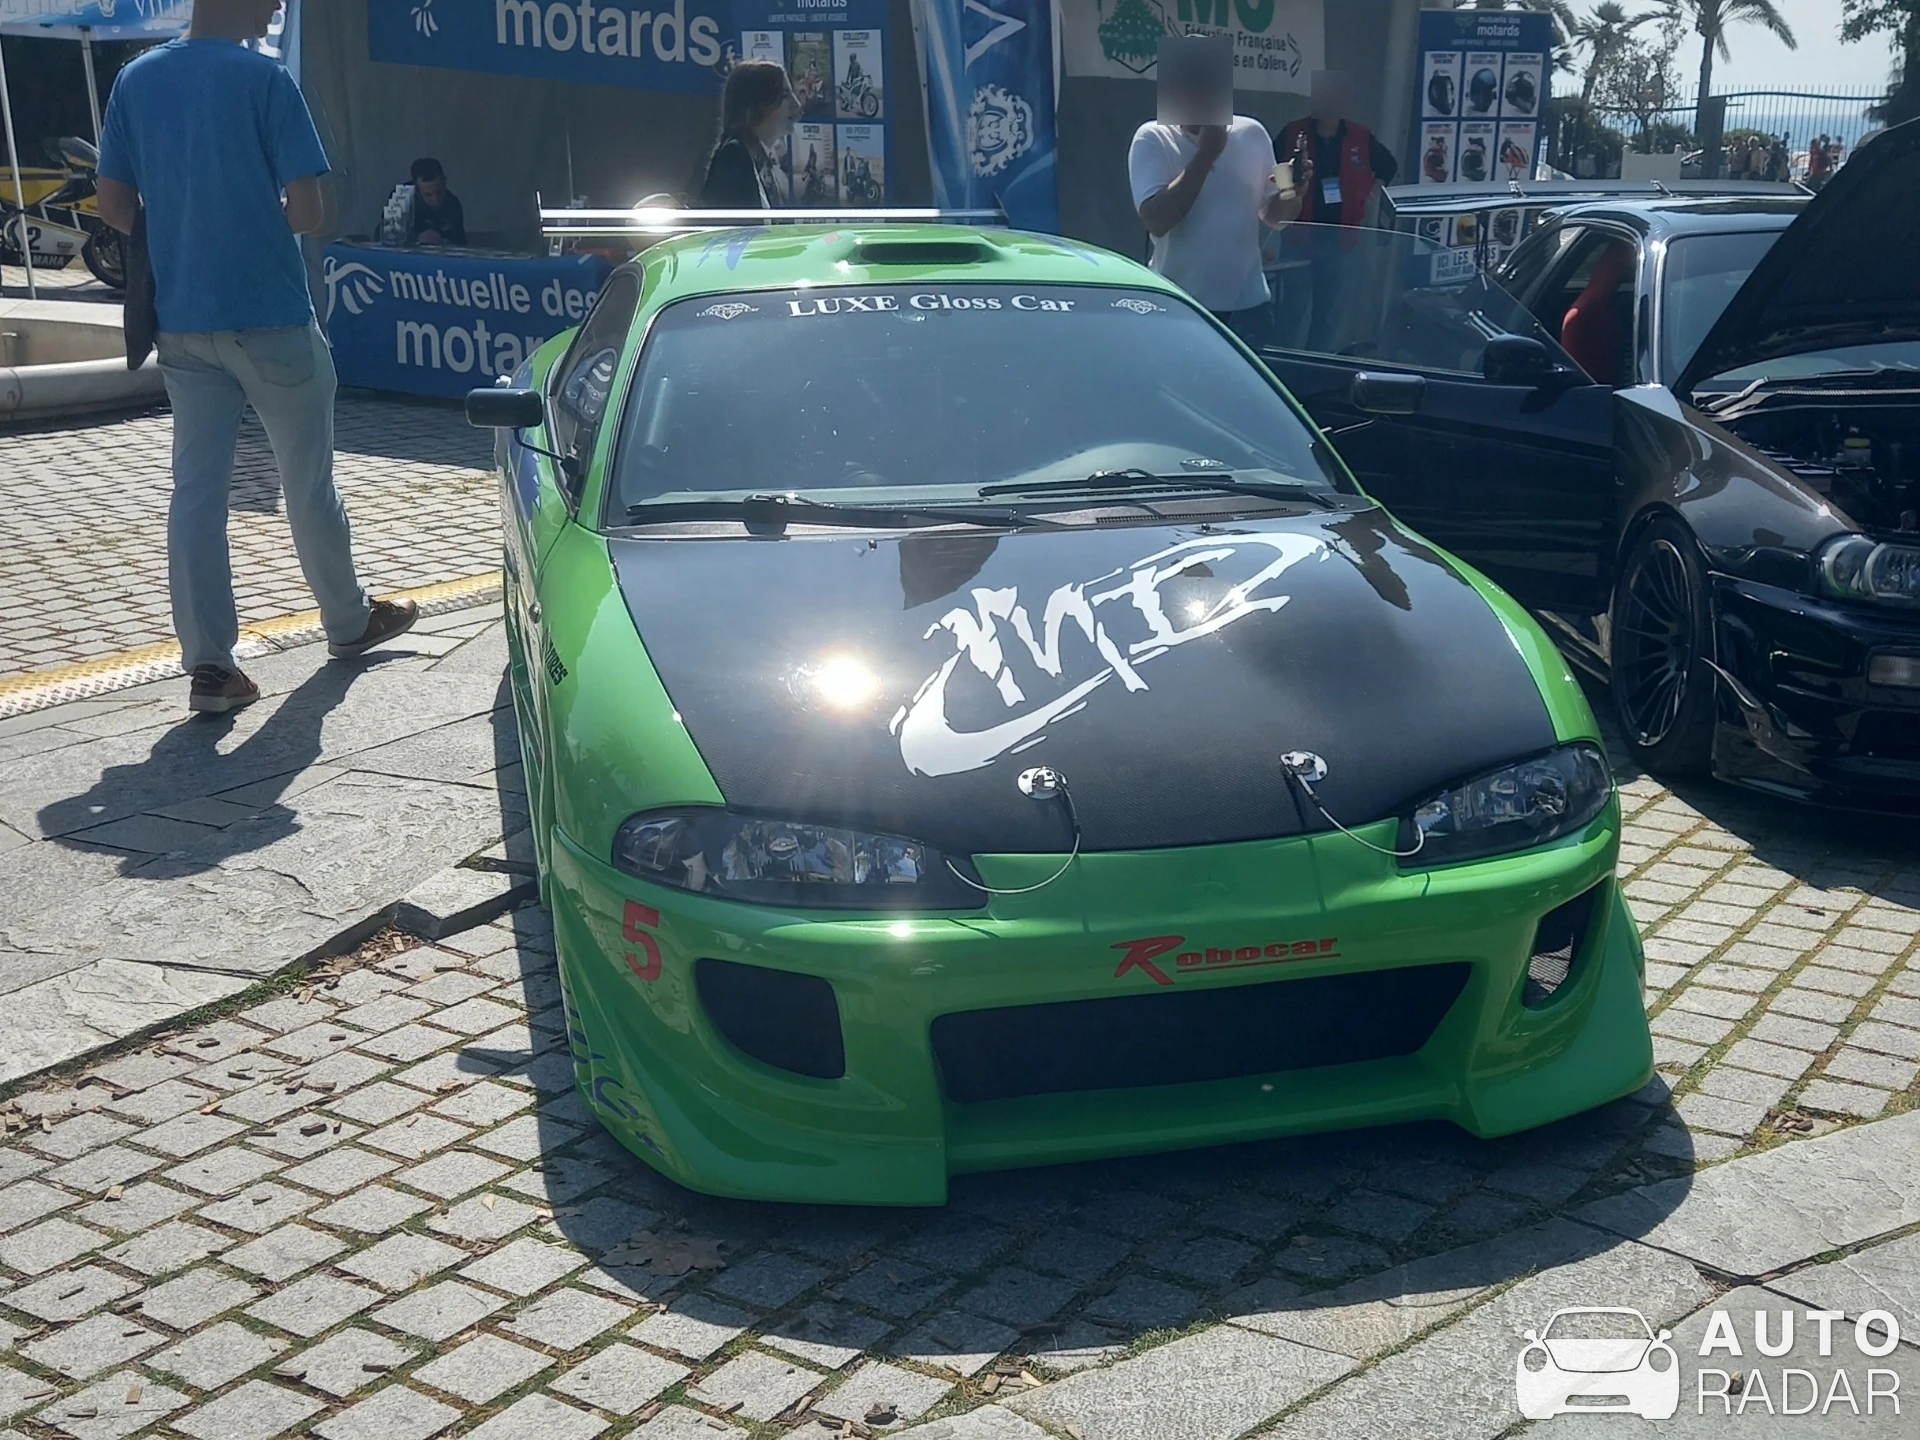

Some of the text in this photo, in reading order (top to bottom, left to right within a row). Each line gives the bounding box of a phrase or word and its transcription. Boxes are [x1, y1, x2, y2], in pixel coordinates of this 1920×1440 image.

[496, 0, 721, 66] motards
[1238, 31, 1286, 52] Française
[1477, 25, 1520, 36] motards
[1257, 54, 1287, 71] Colère
[20, 254, 64, 266] YMAHA
[389, 269, 601, 319] mutuelle des
[786, 294, 1075, 317] LUXE Gloss Car
[622, 899, 662, 982] 5
[1110, 935, 1338, 985] Robocar
